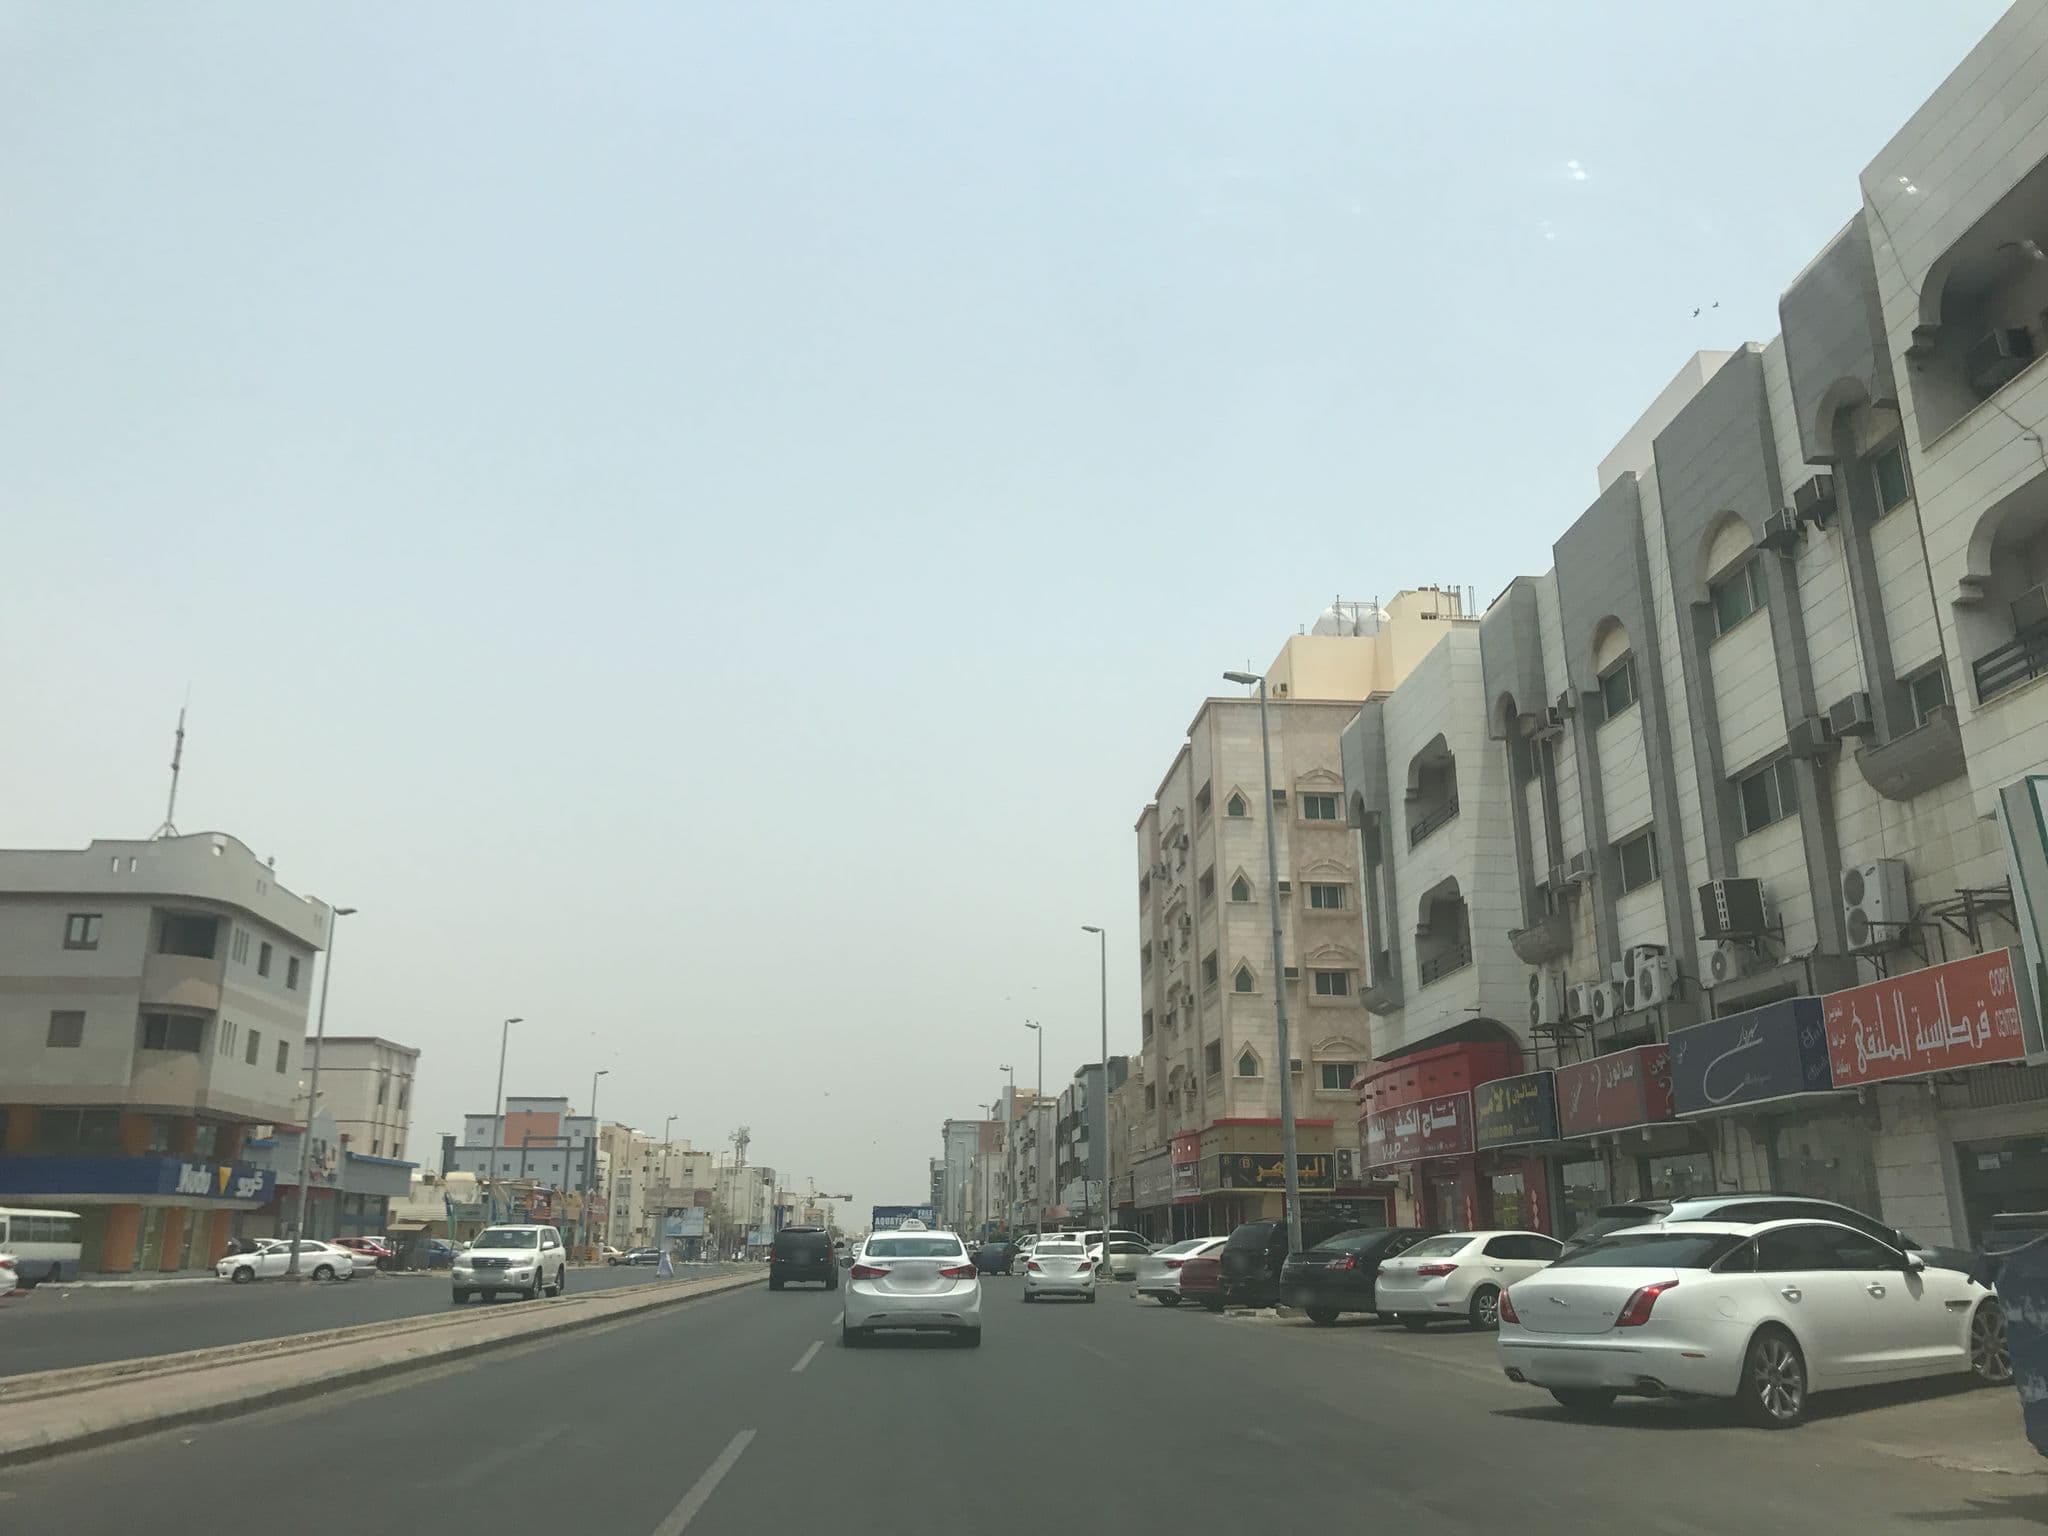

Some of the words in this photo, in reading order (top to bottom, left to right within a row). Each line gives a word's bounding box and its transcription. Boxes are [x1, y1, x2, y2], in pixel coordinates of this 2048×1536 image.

[1915, 974, 1991, 1064] قرطاسية
[1988, 967, 2012, 998] COPY
[1851, 988, 1911, 1074] الملتقى
